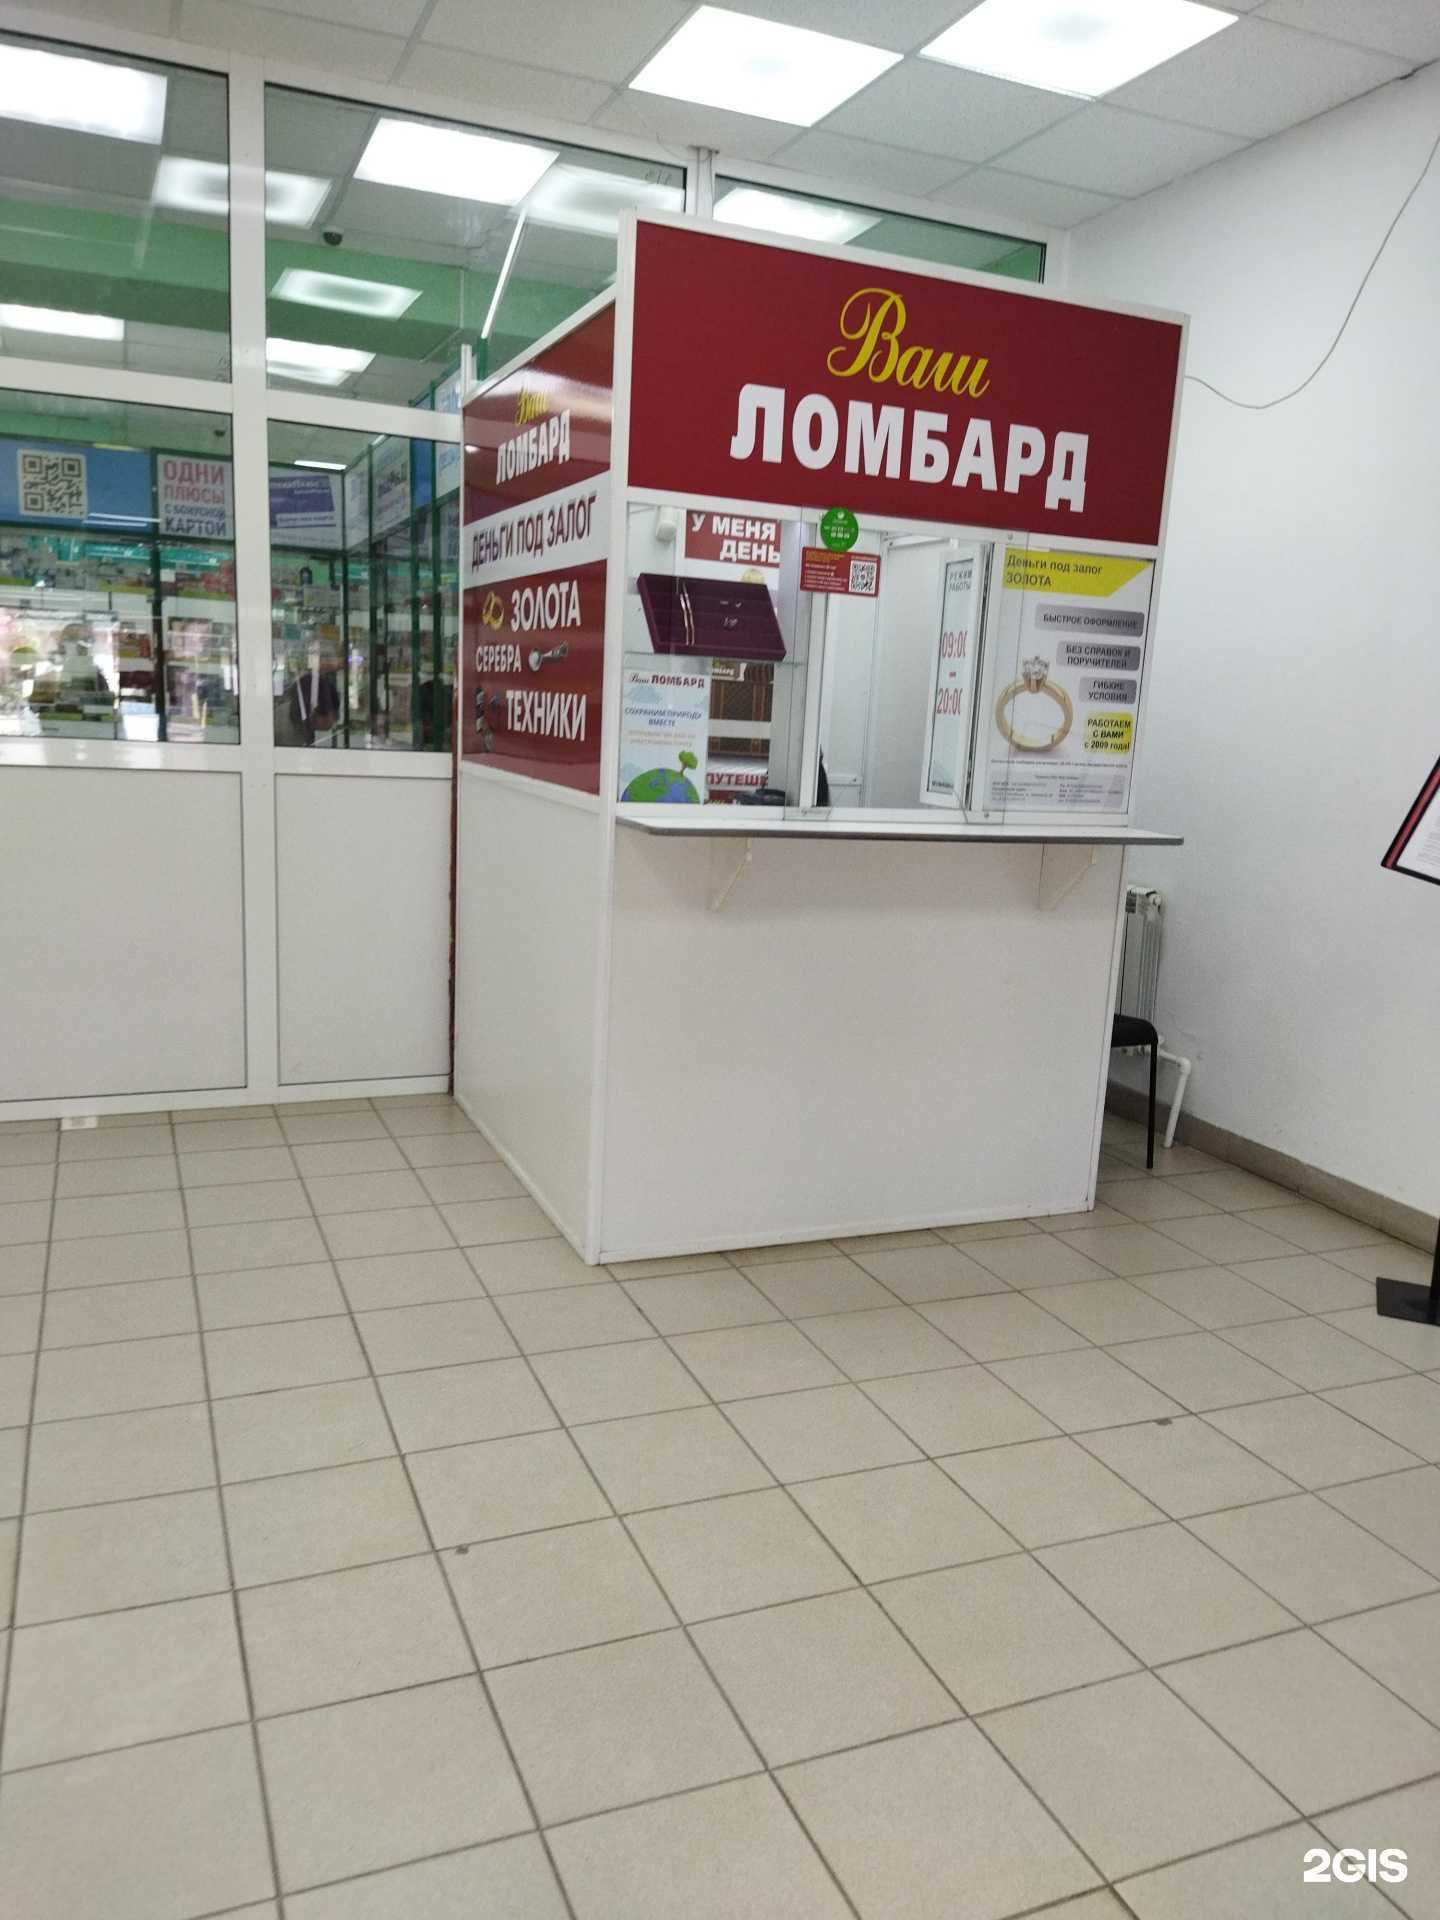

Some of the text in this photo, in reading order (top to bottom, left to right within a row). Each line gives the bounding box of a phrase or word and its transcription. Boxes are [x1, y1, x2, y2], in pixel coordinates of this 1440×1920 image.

[827, 287, 990, 398] Ваш
[514, 386, 549, 427] Ваш
[496, 409, 570, 486] ЛОМБАРД
[729, 383, 1089, 513] ЛОМБАРД
[163, 460, 225, 484] ОДНИ
[163, 486, 225, 505] ПЛЮСЫ
[165, 519, 226, 536] КАРТОЙ
[471, 493, 598, 571] ДЕНЬГИ ПОД ЗАЛОГ
[692, 513, 776, 541] У МЕНЯ
[719, 538, 781, 563] ДЕНЬ
[1006, 555, 1103, 576] Деньги под залог
[1006, 573, 1052, 588] ЗОЛОТА
[510, 580, 581, 632] ЗОЛОТА
[1043, 613, 1138, 629] БЫСТРОЕ ОФОРМЛЕНИЕ
[476, 642, 522, 673] СЕРЕБРА
[1066, 645, 1082, 654] БЕЗ
[1084, 646, 1122, 657] СПРАВОК
[1067, 656, 1127, 669] ПОРУЧИТЕЛЕЙ
[650, 674, 705, 689] ЛОМБАРД
[1093, 680, 1125, 690] ГИБКИЕ
[1088, 691, 1128, 702] УСЛОВИЯ
[505, 689, 587, 742] ТЕХНИКИ
[624, 706, 702, 721] СОХРАНИМ ПРИРОДУ
[648, 718, 676, 728] ВМЕСТЕ
[1087, 718, 1131, 729] РАБОТАЕМ
[1100, 730, 1124, 739] ВАМИ
[1091, 740, 1109, 749] 2009
[1110, 741, 1130, 752] года!
